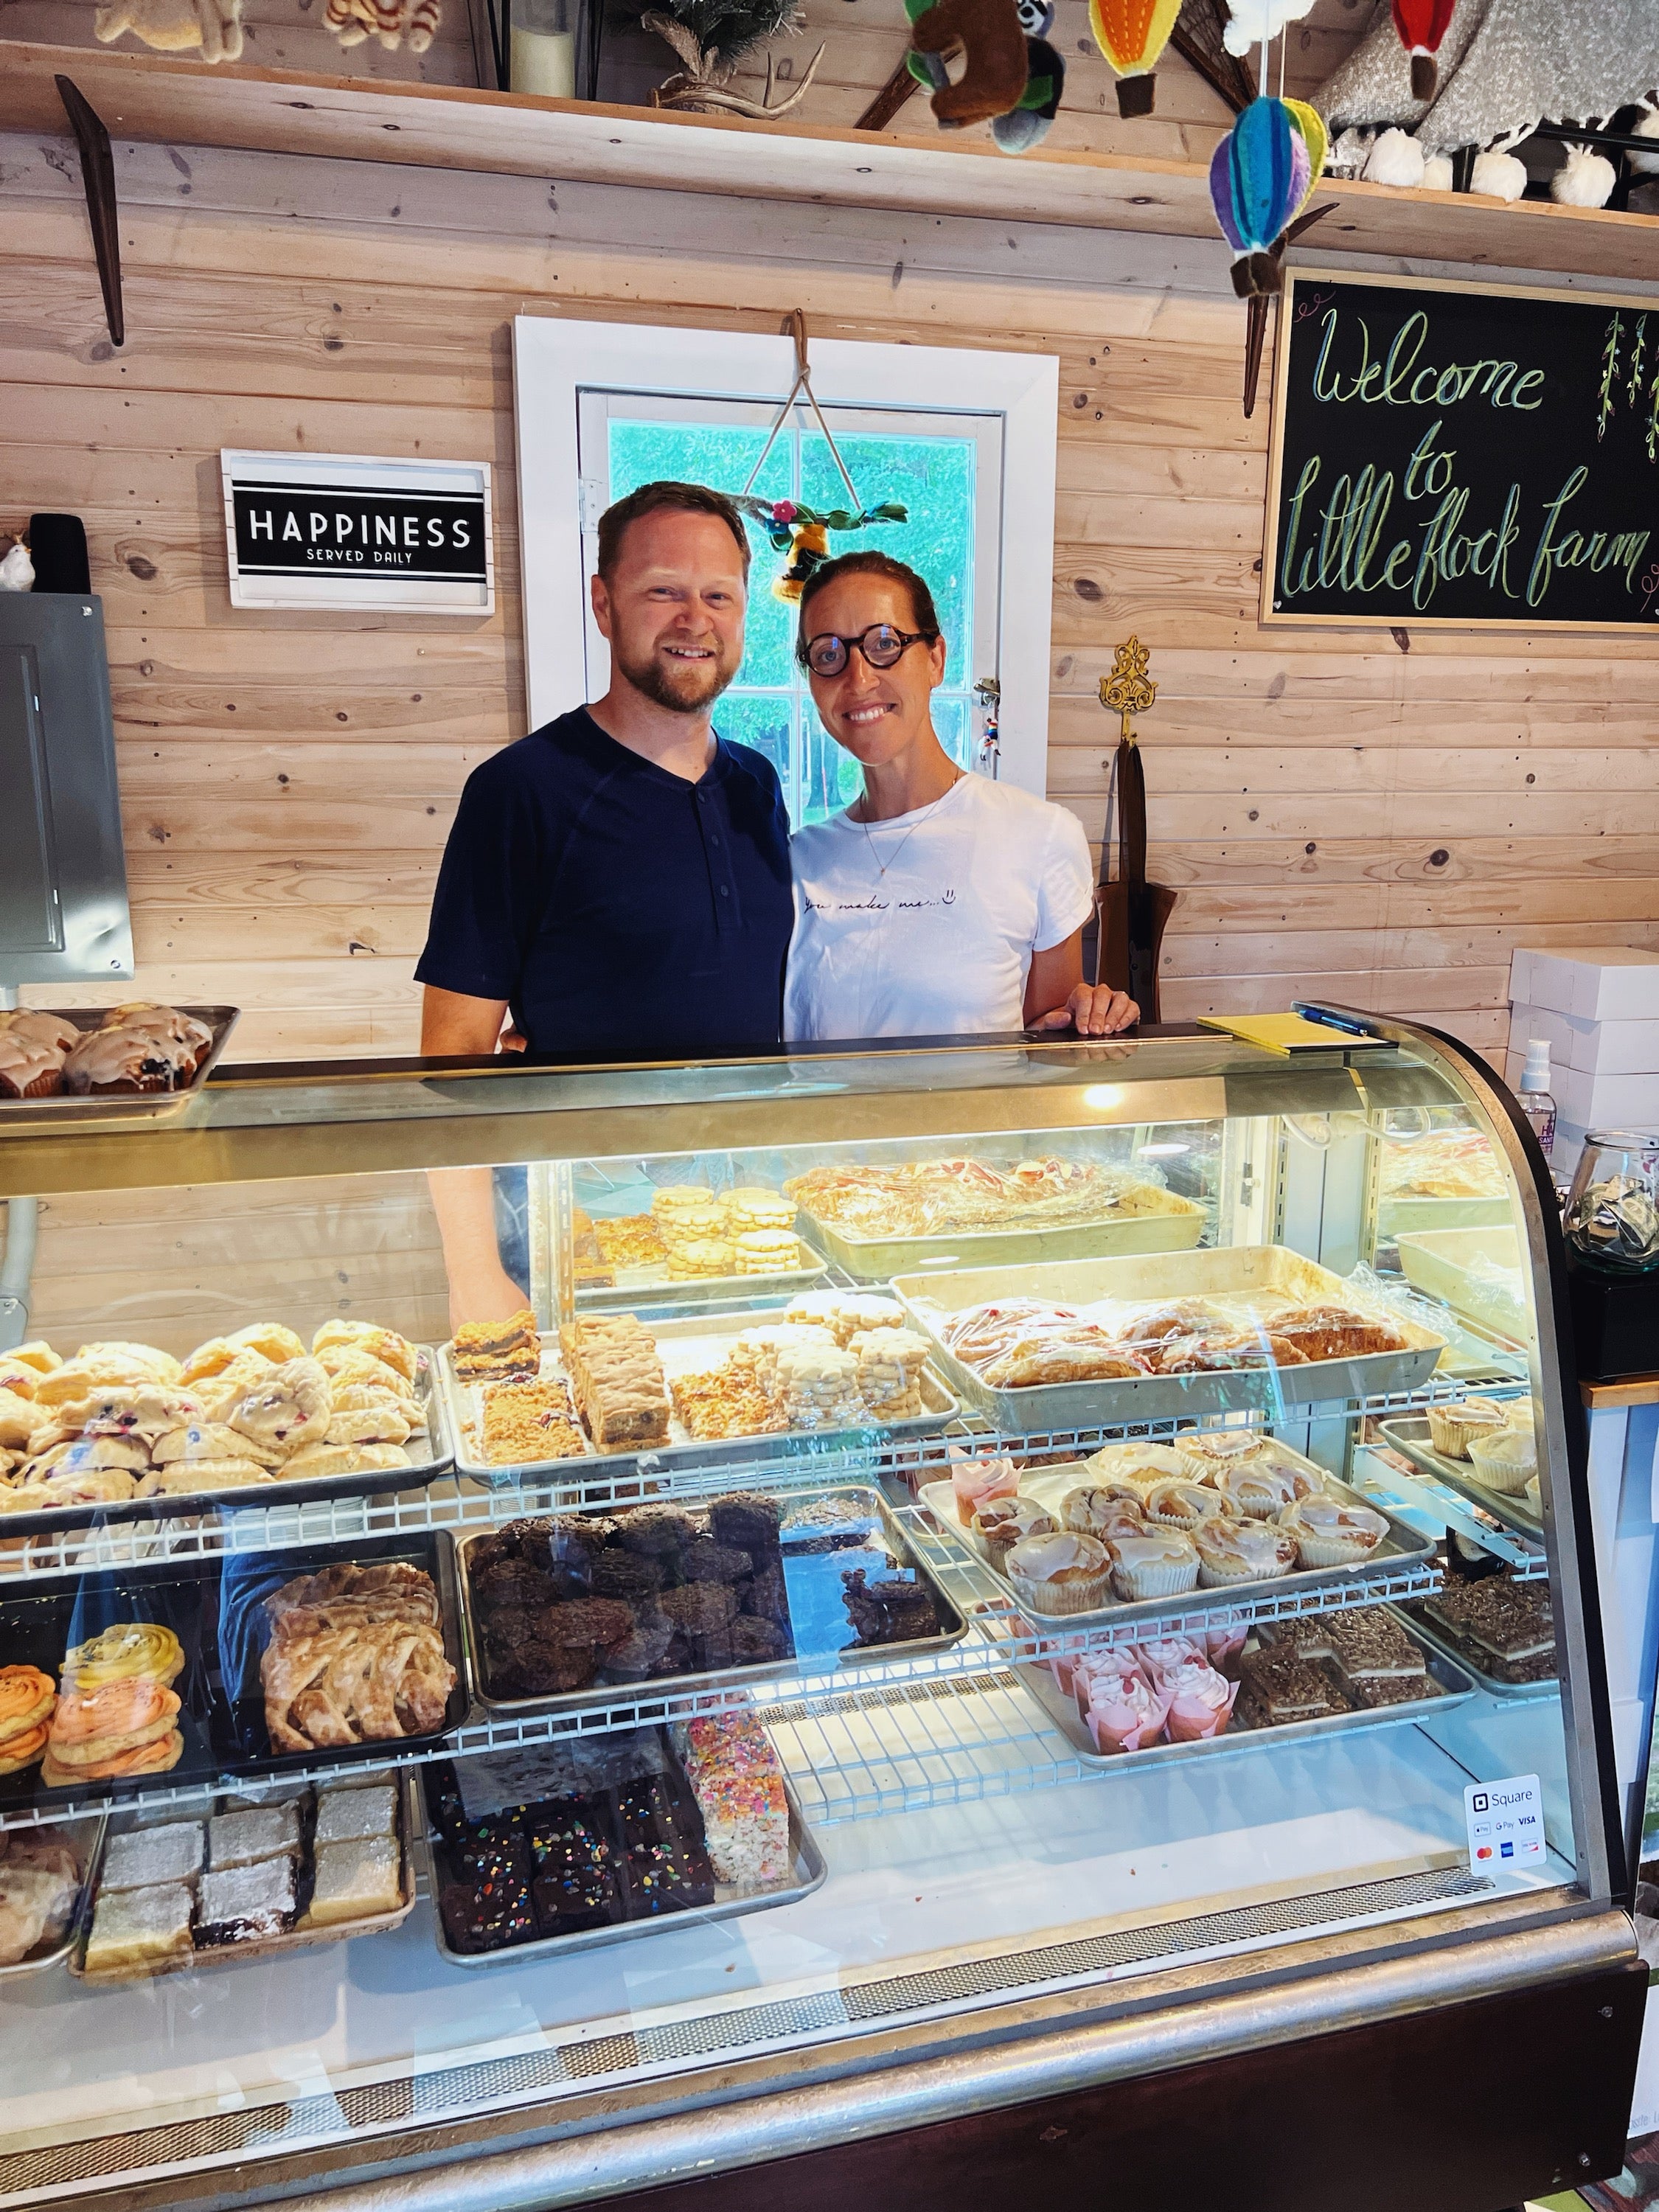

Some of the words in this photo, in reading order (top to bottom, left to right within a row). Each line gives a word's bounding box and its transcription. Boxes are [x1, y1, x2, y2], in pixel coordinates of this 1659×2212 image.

[1313, 308, 1545, 410] Welcome
[1403, 420, 1458, 501] to
[248, 509, 472, 549] HAPPINESS
[306, 548, 365, 563] SERVED
[373, 550, 413, 565] DAILY
[838, 895, 889, 909] make
[1492, 1790, 1533, 1807] Square
[1518, 1815, 1536, 1826] VISA
